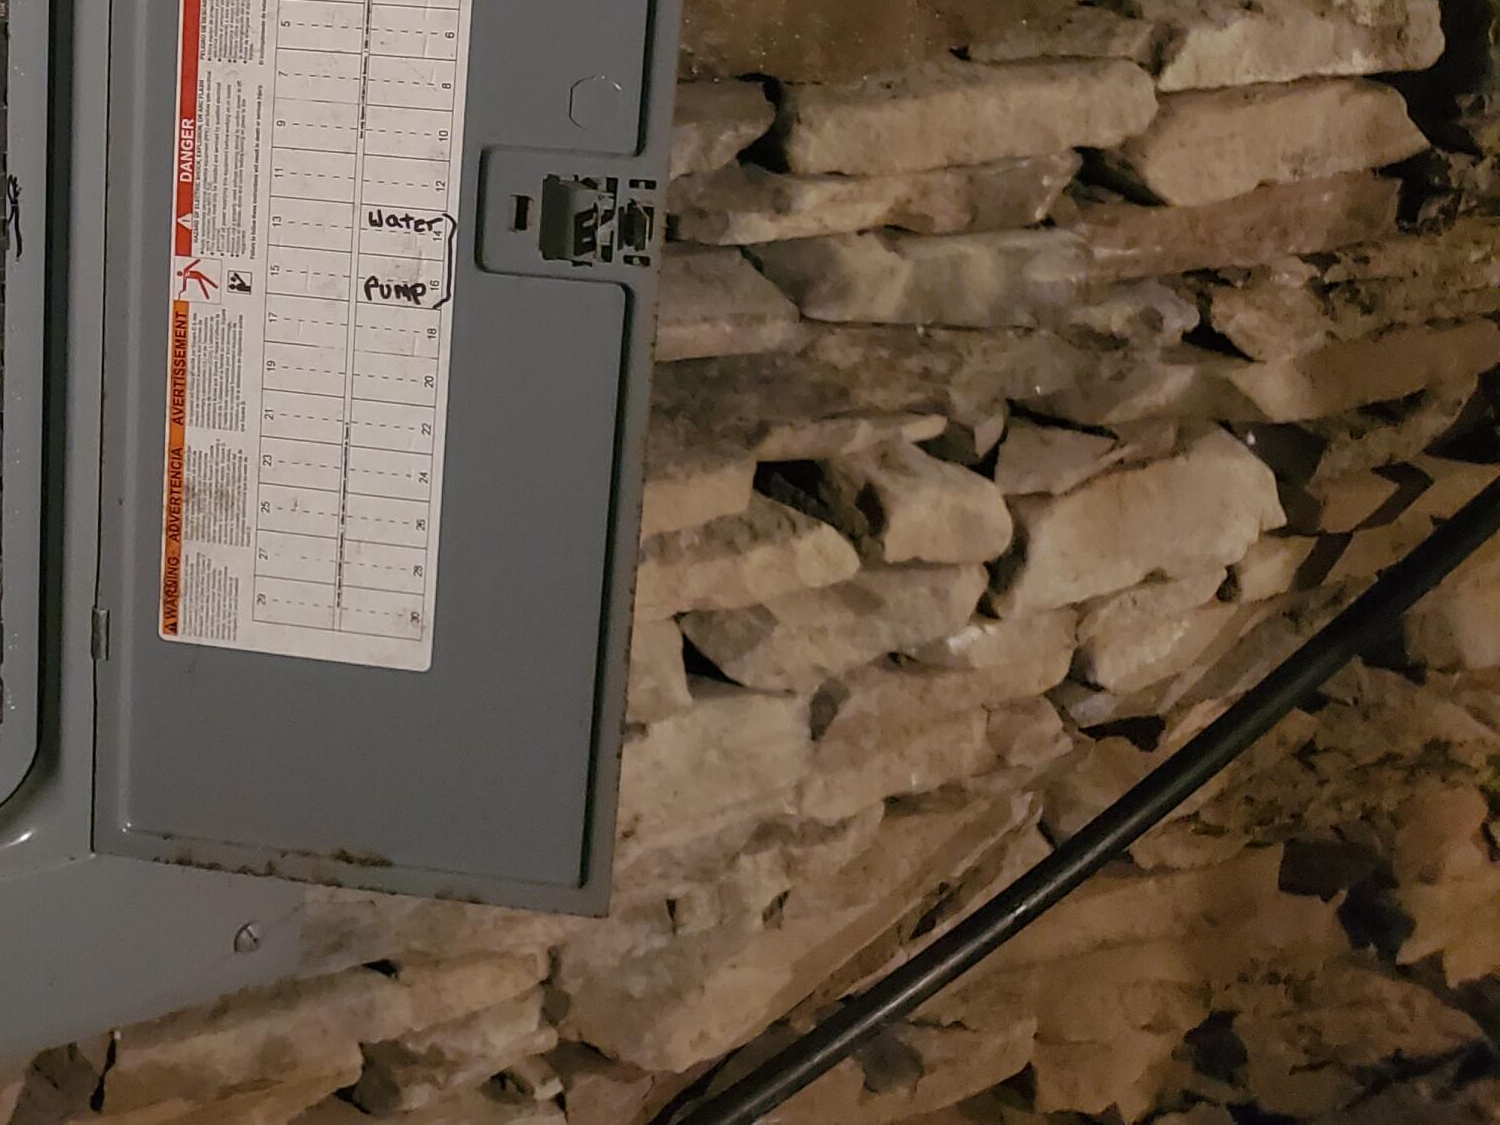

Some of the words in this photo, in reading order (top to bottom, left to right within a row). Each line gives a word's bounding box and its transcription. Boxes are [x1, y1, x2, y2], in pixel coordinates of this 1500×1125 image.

[439, 130, 448, 141] 10
[180, 119, 194, 182] DANGER
[275, 168, 283, 177] 11
[436, 181, 445, 191] 12
[272, 216, 281, 226] 13
[432, 231, 442, 241] 14
[270, 266, 279, 275] 15
[430, 280, 439, 290] 16
[268, 312, 277, 322] 17
[427, 328, 436, 339] 18
[172, 311, 186, 426] AVERTISSEMENT
[267, 361, 275, 371] 19
[424, 376, 434, 388] 20
[264, 410, 274, 420] 21
[421, 423, 431, 435] 22
[263, 455, 272, 467] 23
[419, 472, 428, 483] 24
[169, 448, 182, 542] ADVERTENCIA
[261, 502, 270, 513] 25
[416, 520, 425, 530] 26
[258, 548, 268, 560] 27
[413, 566, 422, 577] 28
[165, 557, 179, 619] WARNING
[257, 594, 265, 605] 29
[411, 612, 419, 623] 30
